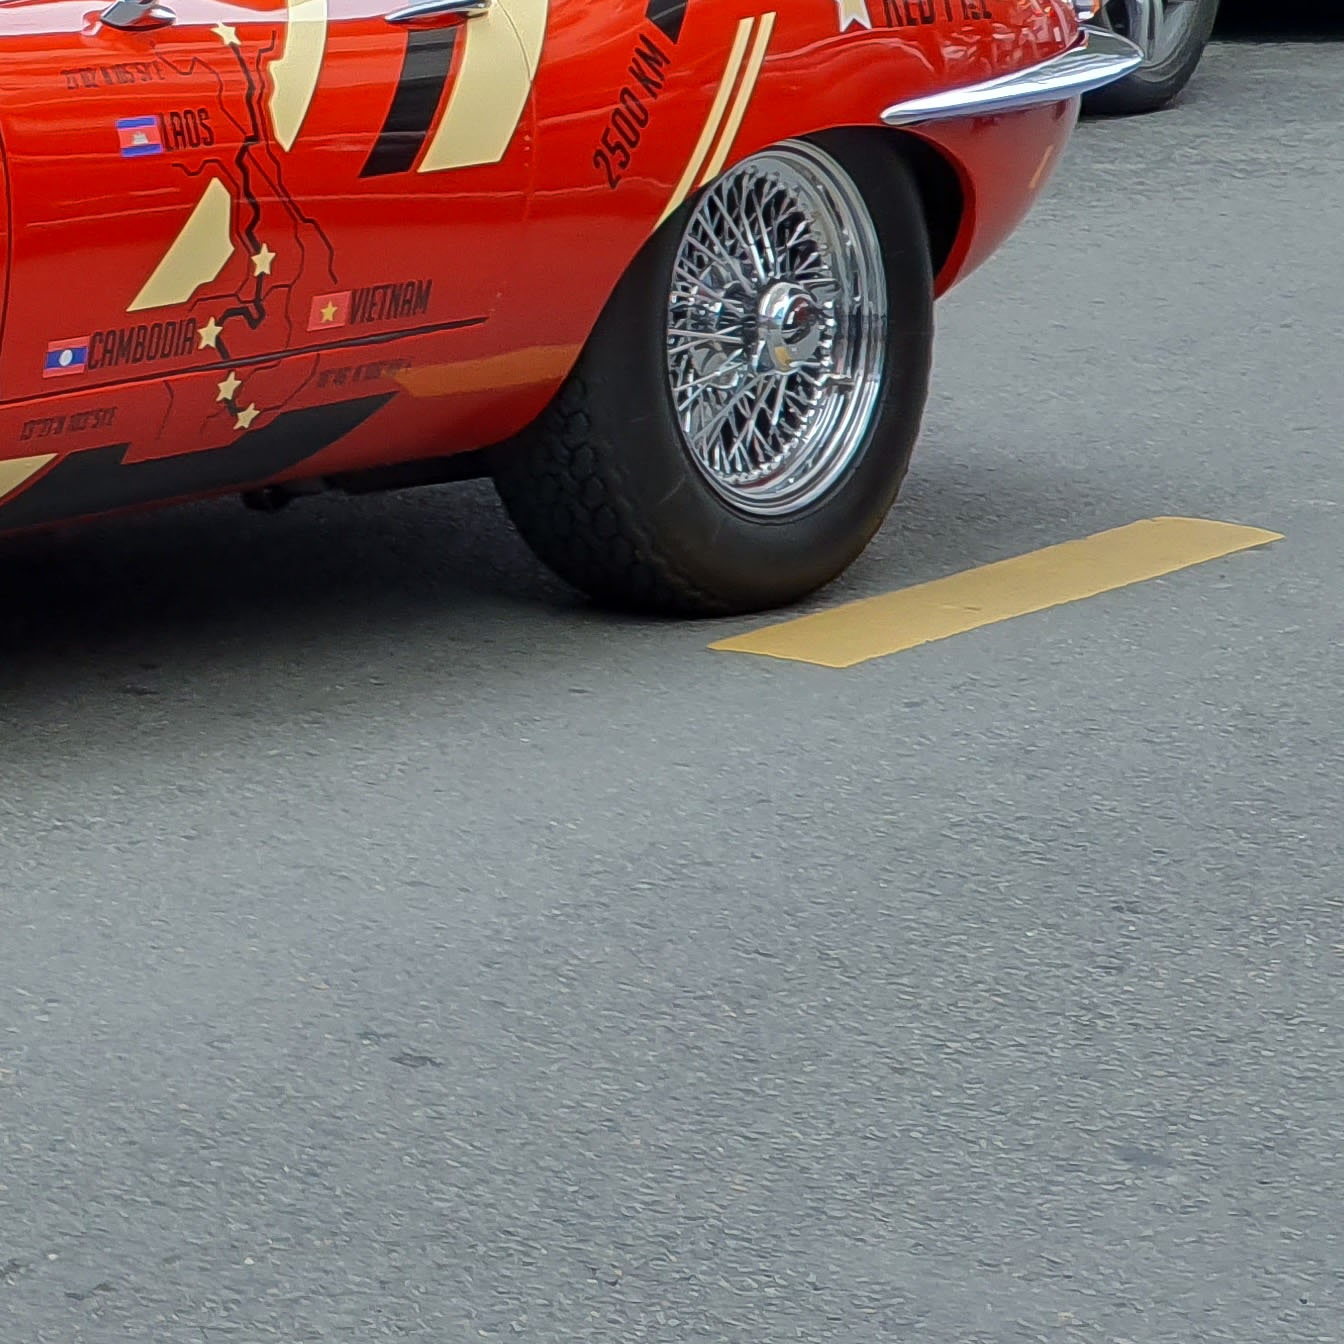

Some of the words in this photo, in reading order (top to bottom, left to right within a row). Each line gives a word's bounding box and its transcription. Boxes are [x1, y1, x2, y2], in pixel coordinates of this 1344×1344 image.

[159, 108, 215, 152] LAOS
[593, 86, 650, 190] 2500
[628, 33, 671, 100] KM
[348, 278, 433, 325] VIETNAM
[87, 317, 197, 370] CAMBODIA
